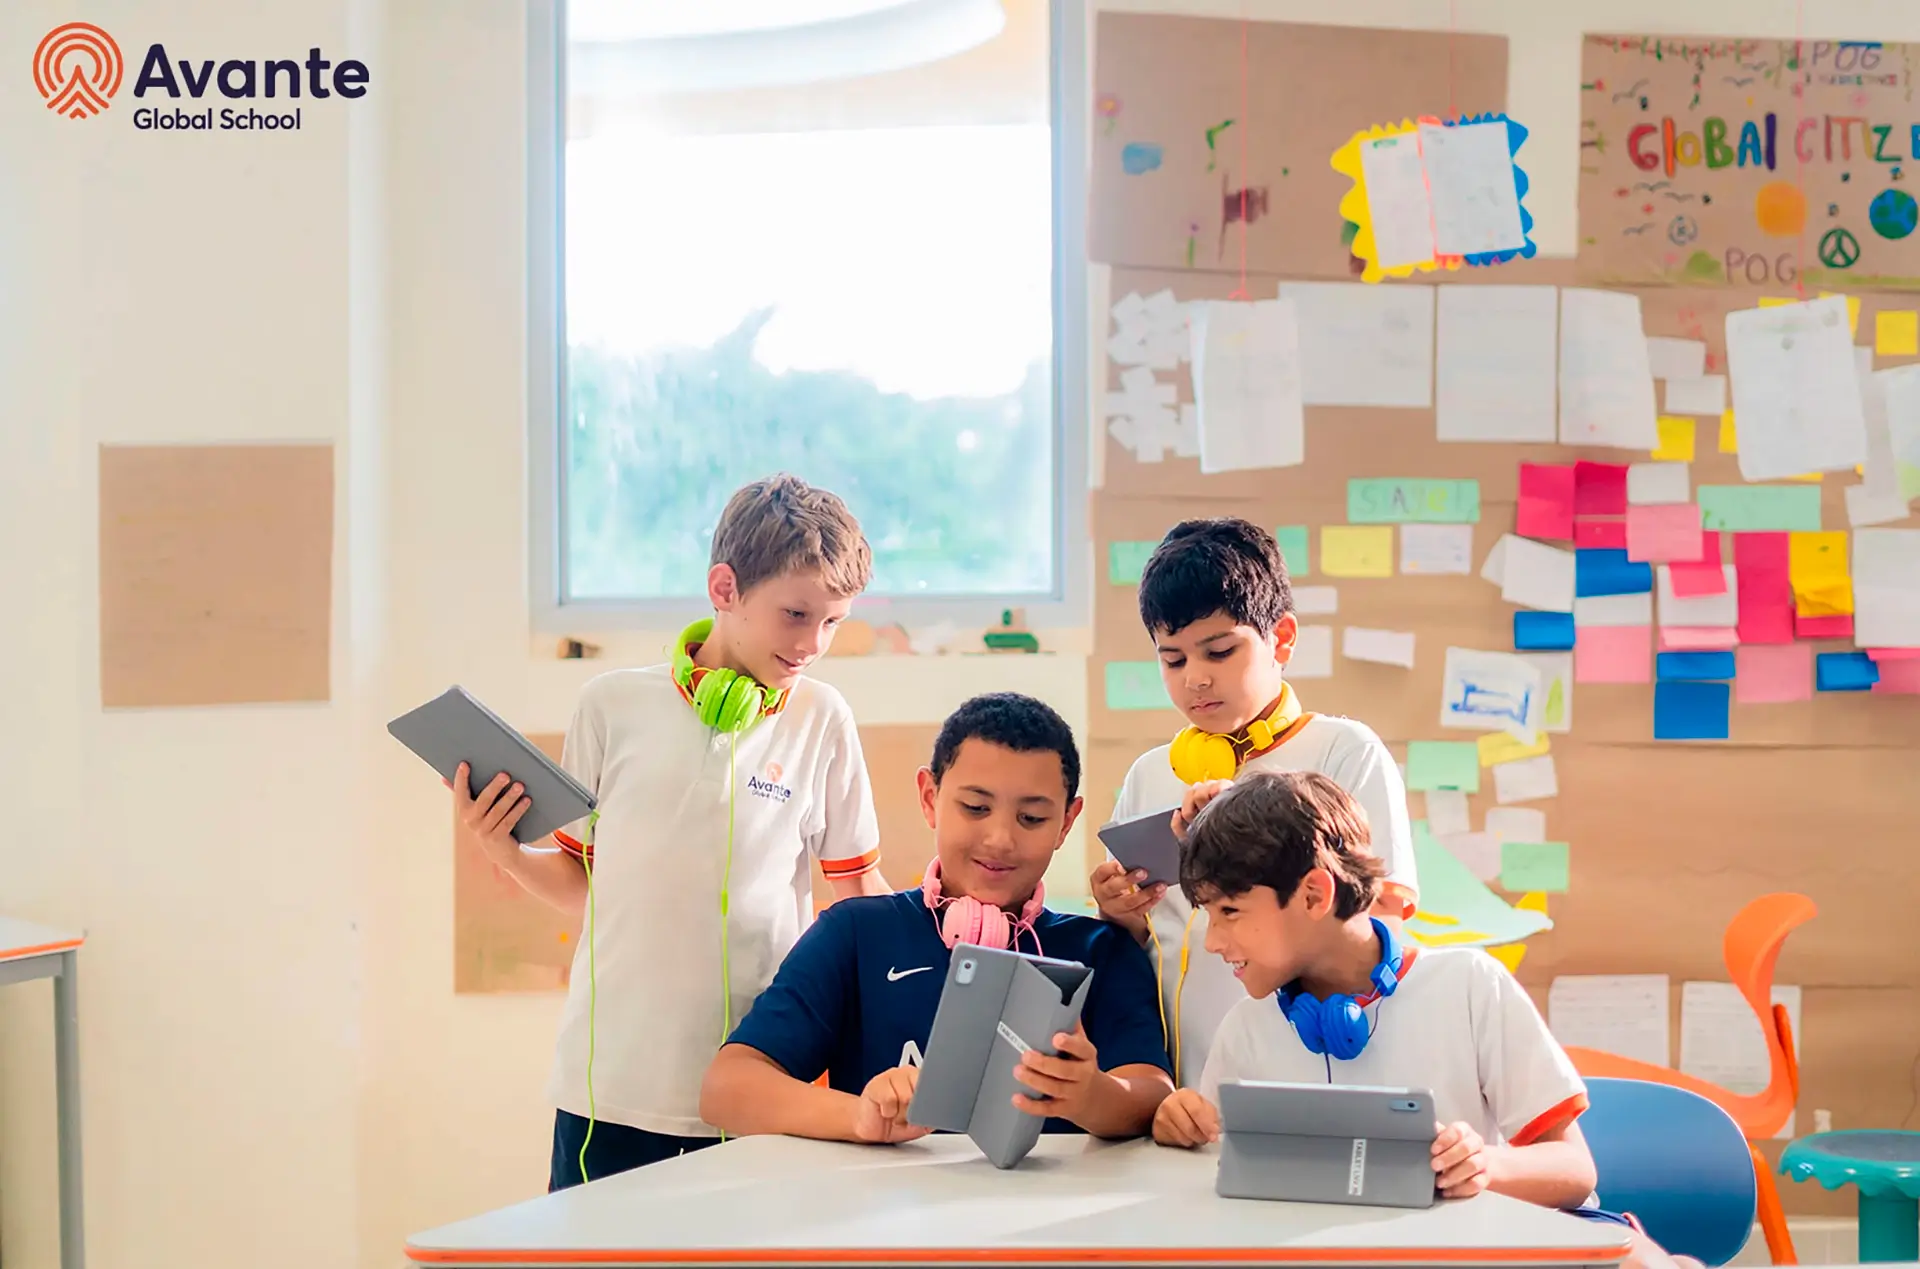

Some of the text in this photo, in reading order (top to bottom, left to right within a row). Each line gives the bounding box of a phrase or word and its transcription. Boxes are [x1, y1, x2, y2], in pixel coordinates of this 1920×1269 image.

[1812, 41, 1881, 71] POG
[1724, 247, 1797, 285] POG
[748, 776, 791, 798] Avante
